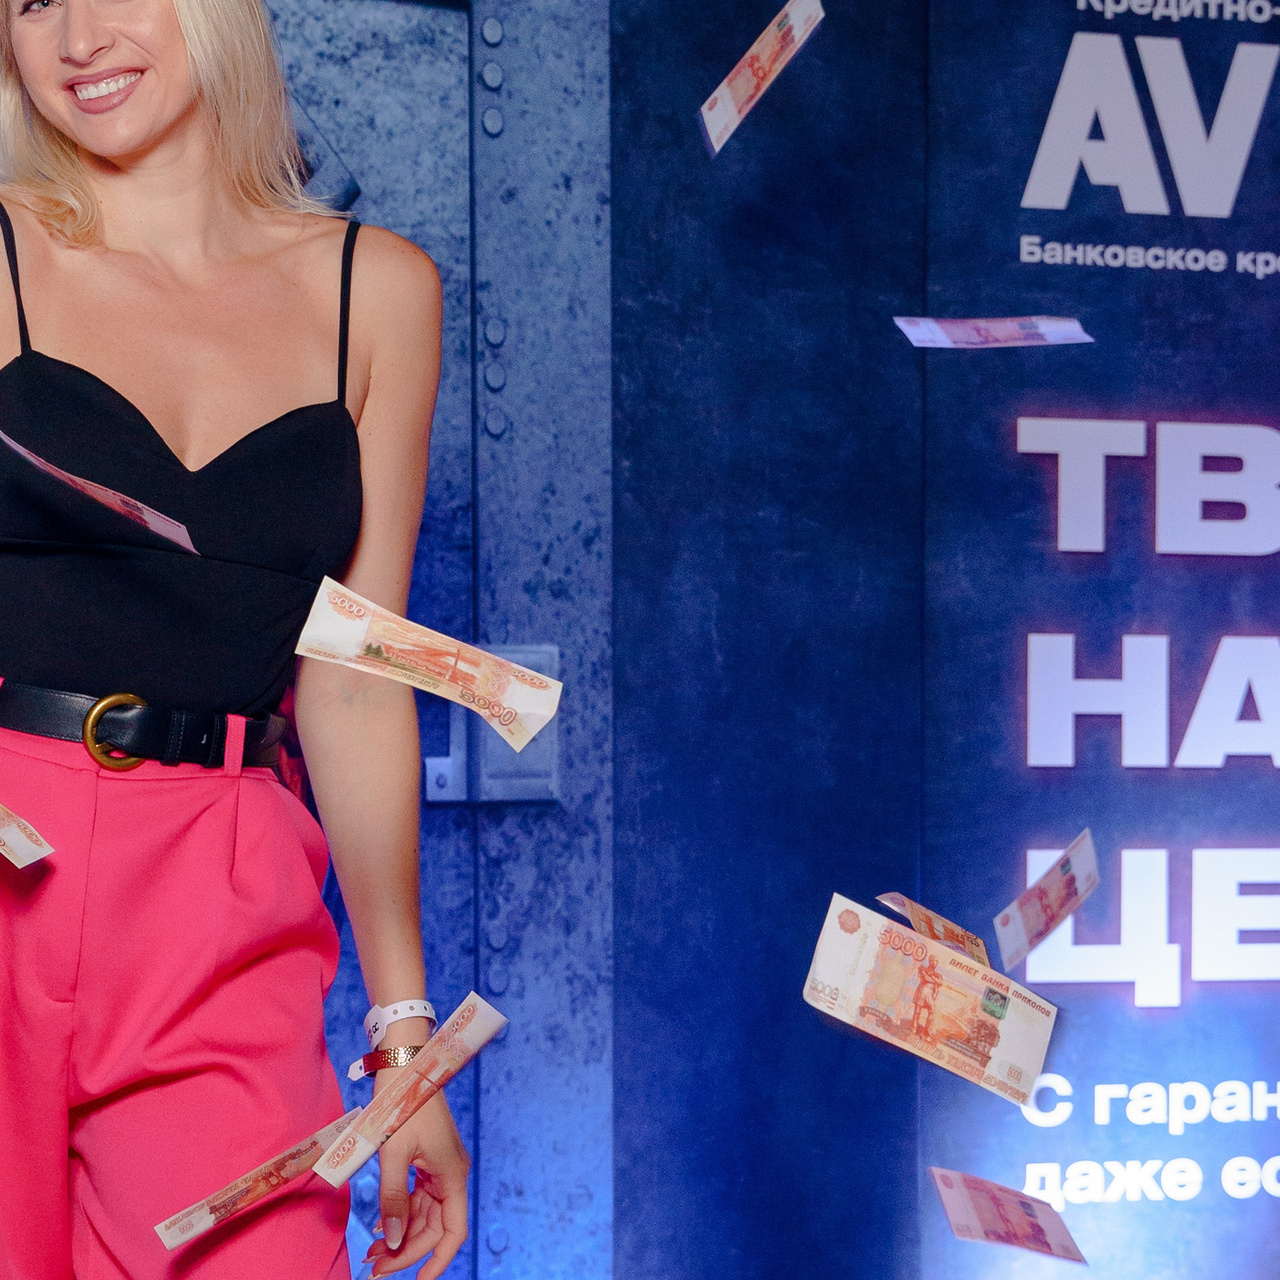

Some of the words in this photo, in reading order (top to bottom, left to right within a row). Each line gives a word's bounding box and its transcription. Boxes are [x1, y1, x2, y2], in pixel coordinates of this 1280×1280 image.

[1020, 31, 1280, 219] AV
[1020, 234, 1228, 272] Банковское
[1017, 417, 1280, 556] ТВ
[329, 592, 366, 618] 5000
[510, 669, 548, 688] 5000
[1027, 633, 1280, 769] НА
[458, 687, 518, 727] 5000
[877, 924, 928, 962] 5000
[1026, 848, 1280, 1008] ЦЕ
[949, 958, 979, 977] БИЛЕТ
[980, 973, 1010, 993] БАНКА
[1011, 989, 1052, 1018] ПРИКОЛОВ
[448, 1004, 477, 1034] 5000
[1021, 1072, 1073, 1127] С
[328, 1136, 356, 1168] 5000
[1022, 1156, 1204, 1212] даже
